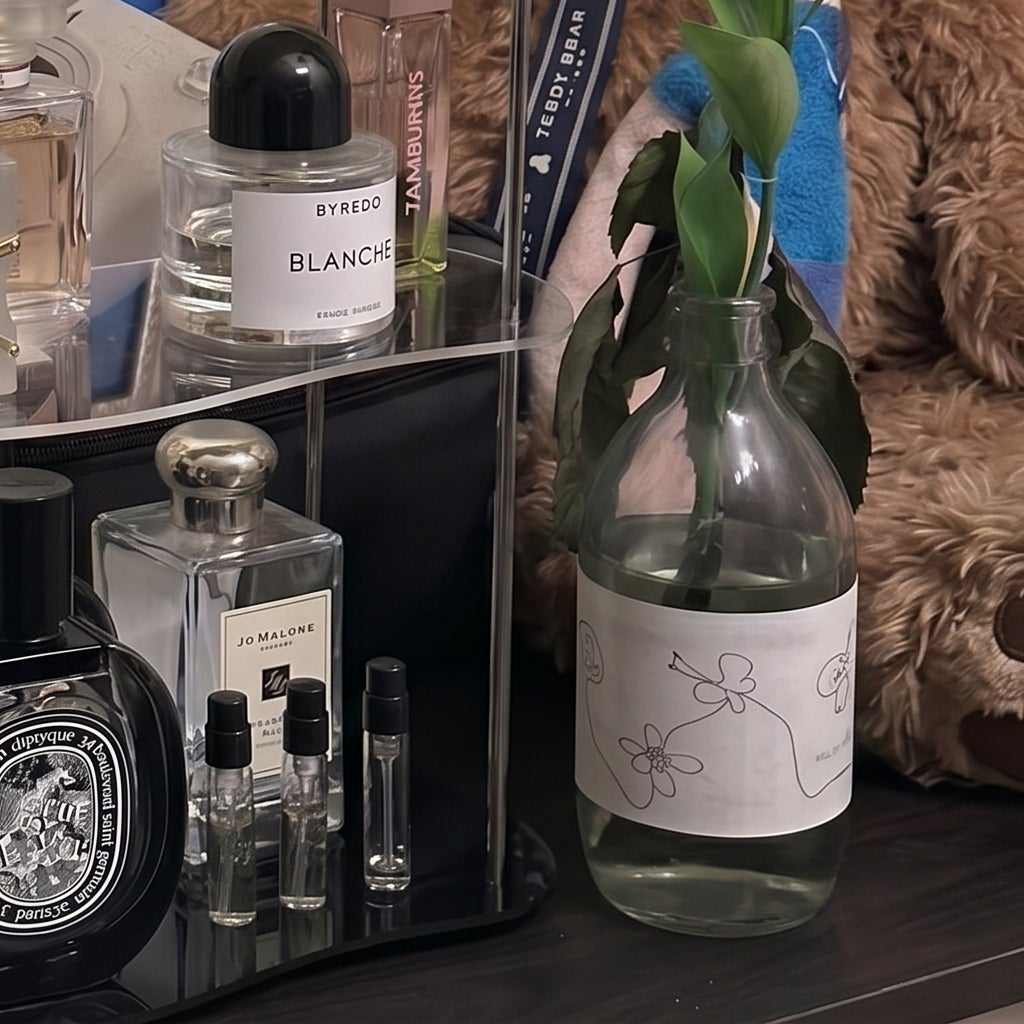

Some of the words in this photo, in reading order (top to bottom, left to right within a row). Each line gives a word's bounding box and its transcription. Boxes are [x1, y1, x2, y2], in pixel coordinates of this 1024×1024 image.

[316, 195, 381, 217] BYREDO
[290, 238, 392, 272] BLANCHE
[237, 636, 254, 647] JO
